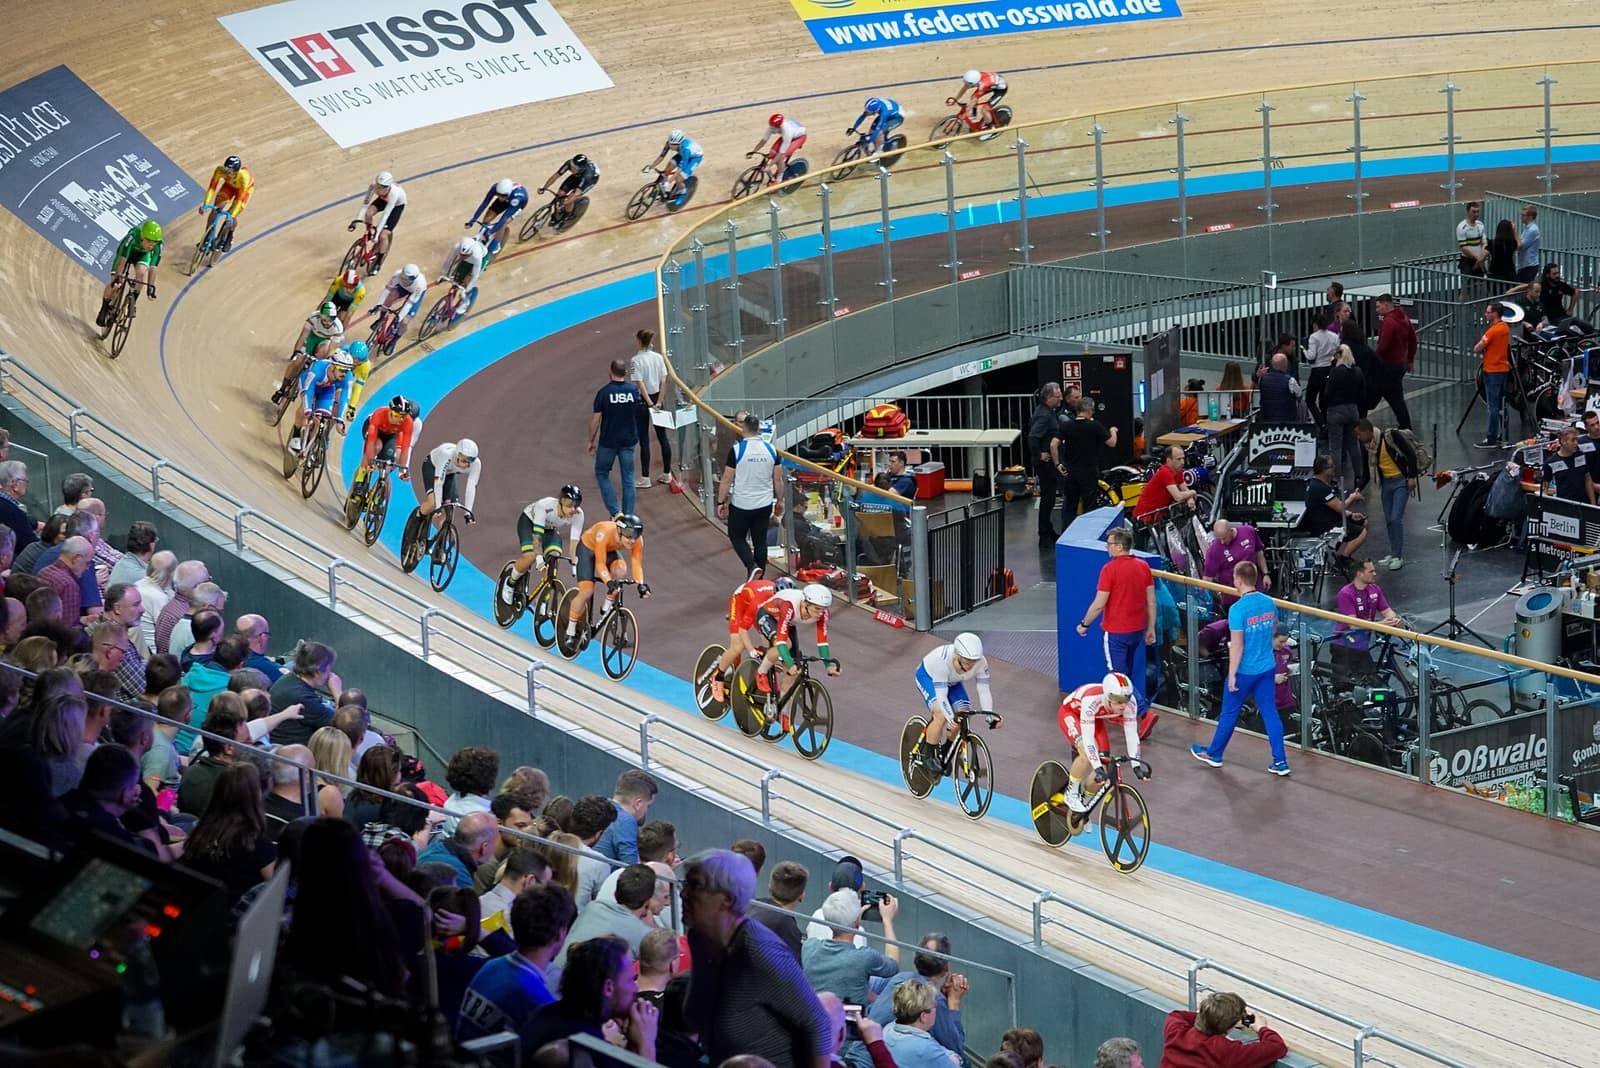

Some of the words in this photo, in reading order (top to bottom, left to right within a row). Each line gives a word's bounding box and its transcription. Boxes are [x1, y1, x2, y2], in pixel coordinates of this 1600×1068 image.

[327, 0, 548, 68] TISSOT
[825, 0, 1163, 46] www.federn-osswald.de
[308, 87, 372, 118] SWISS
[370, 66, 464, 101] WATCHES
[467, 53, 531, 80] SINCE
[533, 45, 583, 68] 1853
[609, 392, 634, 404] USA
[1550, 518, 1577, 534] Berlin
[877, 611, 898, 626] BERLIN
